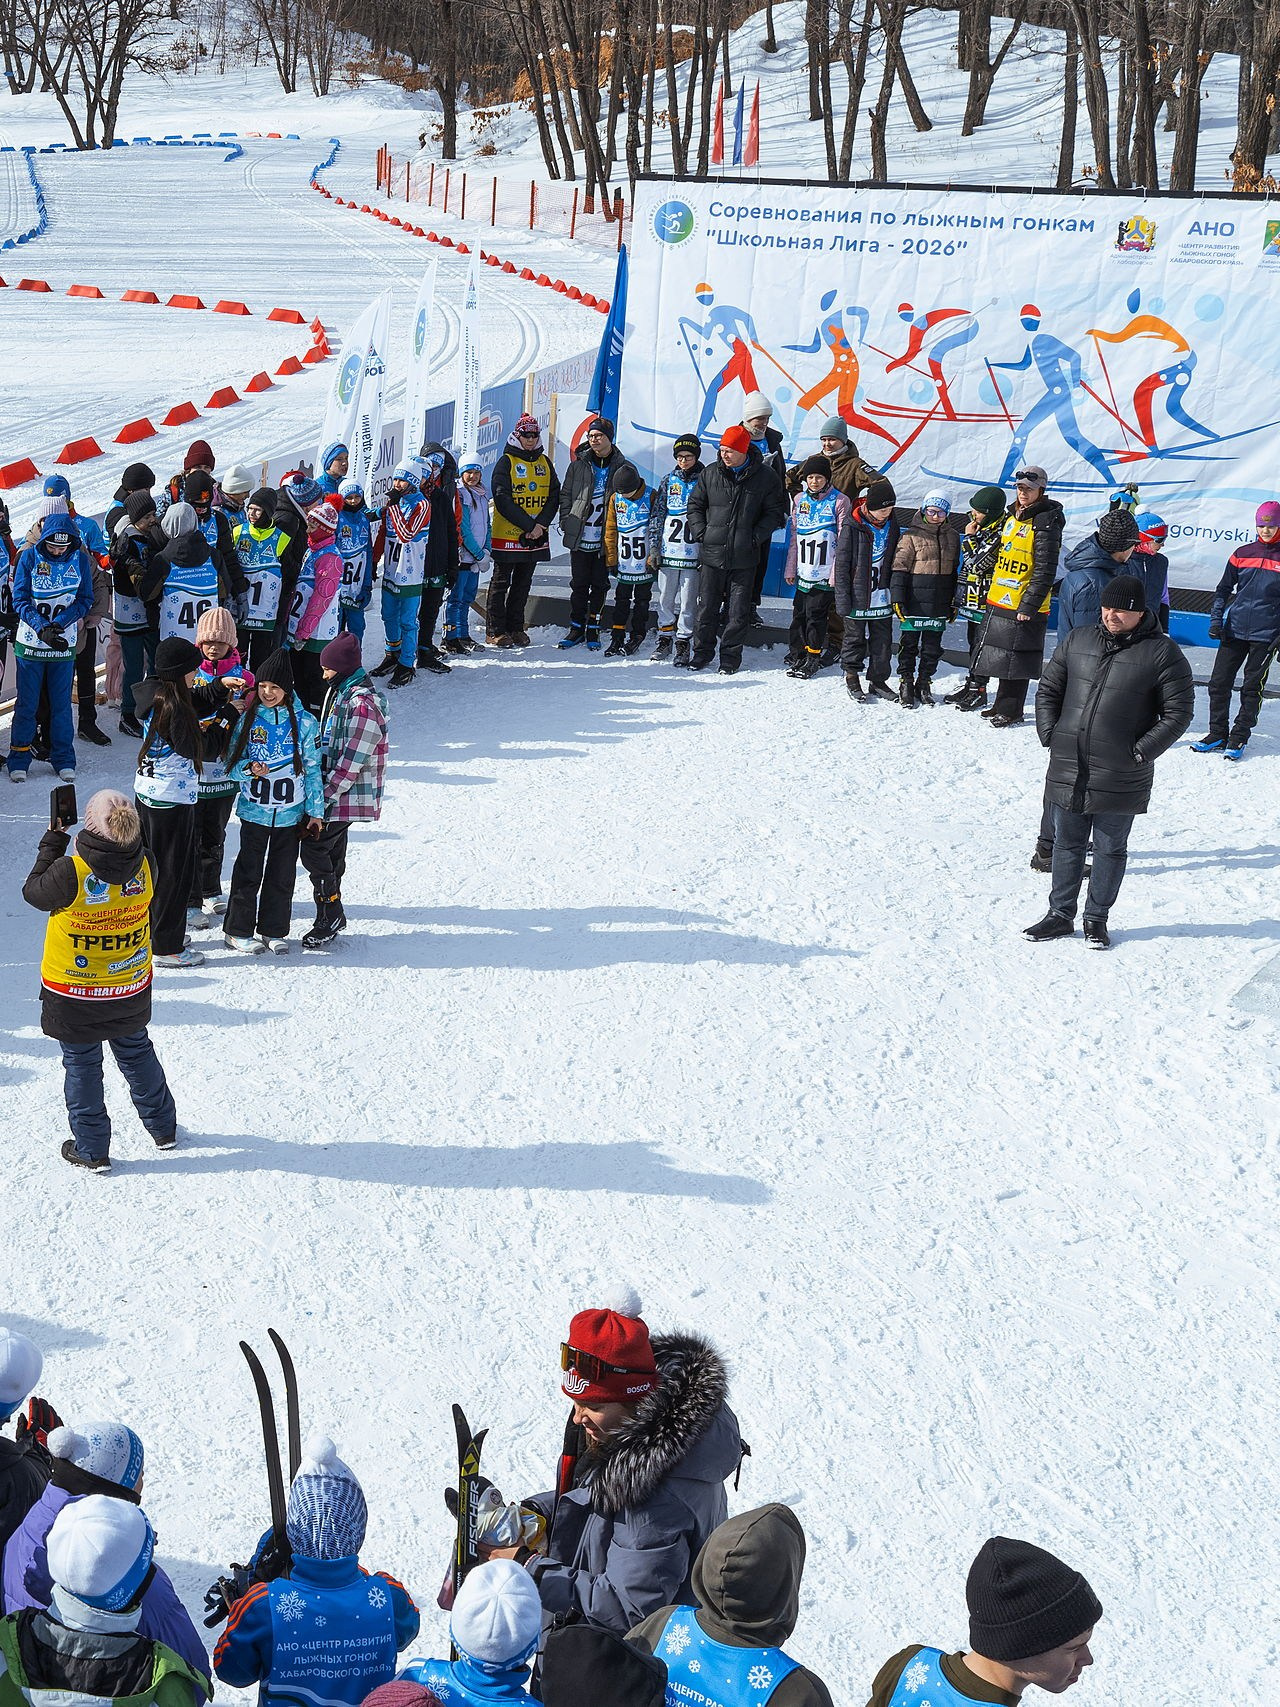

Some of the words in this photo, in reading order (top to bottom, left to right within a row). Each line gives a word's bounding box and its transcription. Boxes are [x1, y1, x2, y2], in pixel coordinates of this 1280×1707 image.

[708, 201, 862, 224] Соревнования
[870, 209, 896, 225] по
[902, 211, 1004, 231] лыжным
[1013, 216, 1095, 233] гонкам
[1187, 221, 1235, 237] АНО
[707, 229, 824, 252] "Школьная
[829, 234, 880, 254] Лига
[901, 238, 968, 257] 2026"
[621, 536, 646, 560] 55
[799, 538, 828, 566] 111
[343, 561, 363, 587] 64
[72, 910, 90, 919] АНО
[468, 1480, 480, 1558] FISCHER
[276, 1642, 299, 1652] АНО
[301, 1639, 341, 1650] «ЦЕНТР
[343, 1633, 392, 1649] РАЗВИТИЯ
[293, 1654, 342, 1665] ЛЫЖНЫХ
[344, 1651, 378, 1663] ГОНОК
[280, 1667, 361, 1679] ХАБАРОВСКОГО
[363, 1663, 392, 1677] КРАЯ»
[667, 1681, 705, 1703] «ЦЕНТР
